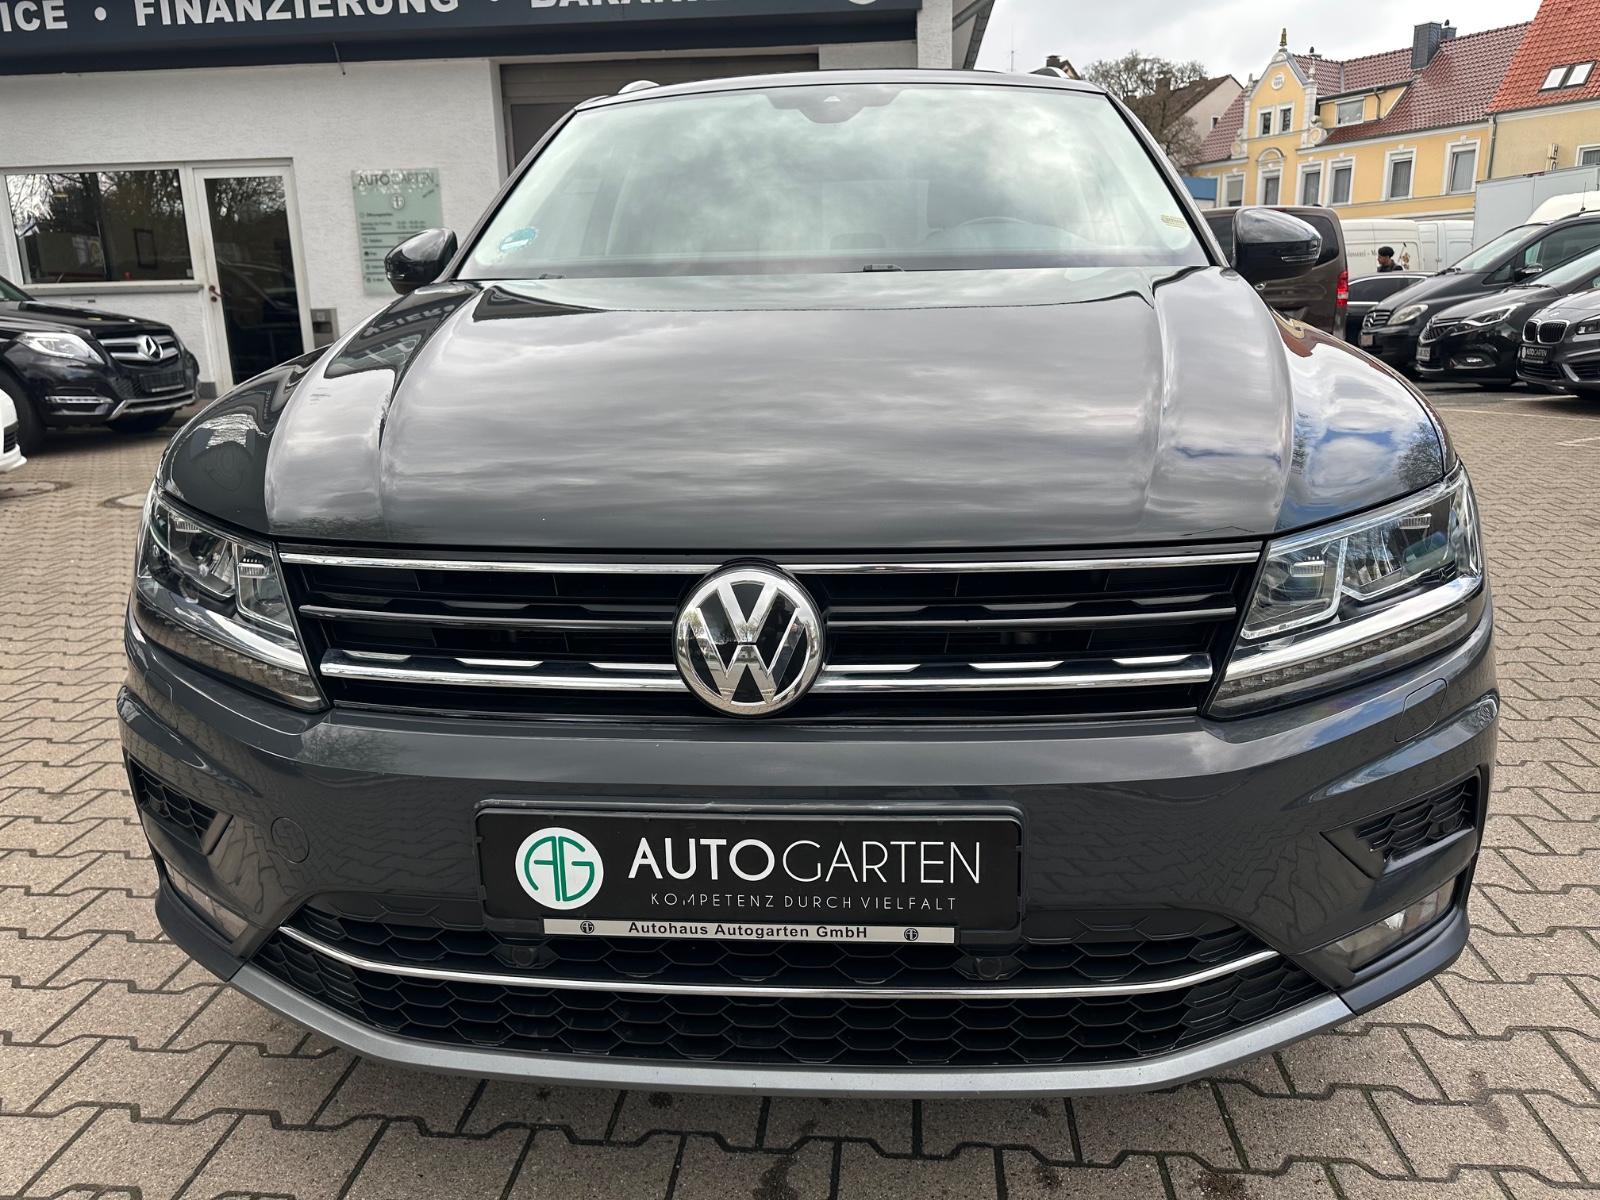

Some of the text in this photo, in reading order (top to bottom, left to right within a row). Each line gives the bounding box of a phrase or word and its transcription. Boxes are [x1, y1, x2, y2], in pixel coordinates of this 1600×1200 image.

[0, 0, 68, 32] ICE
[627, 837, 981, 884] AUTOGARTEN
[651, 892, 956, 911] KOMPETENZ DURCH VIELFALT
[628, 922, 708, 935] Autohaus
[714, 924, 809, 939] Autogarten
[816, 925, 867, 938] GmbH
